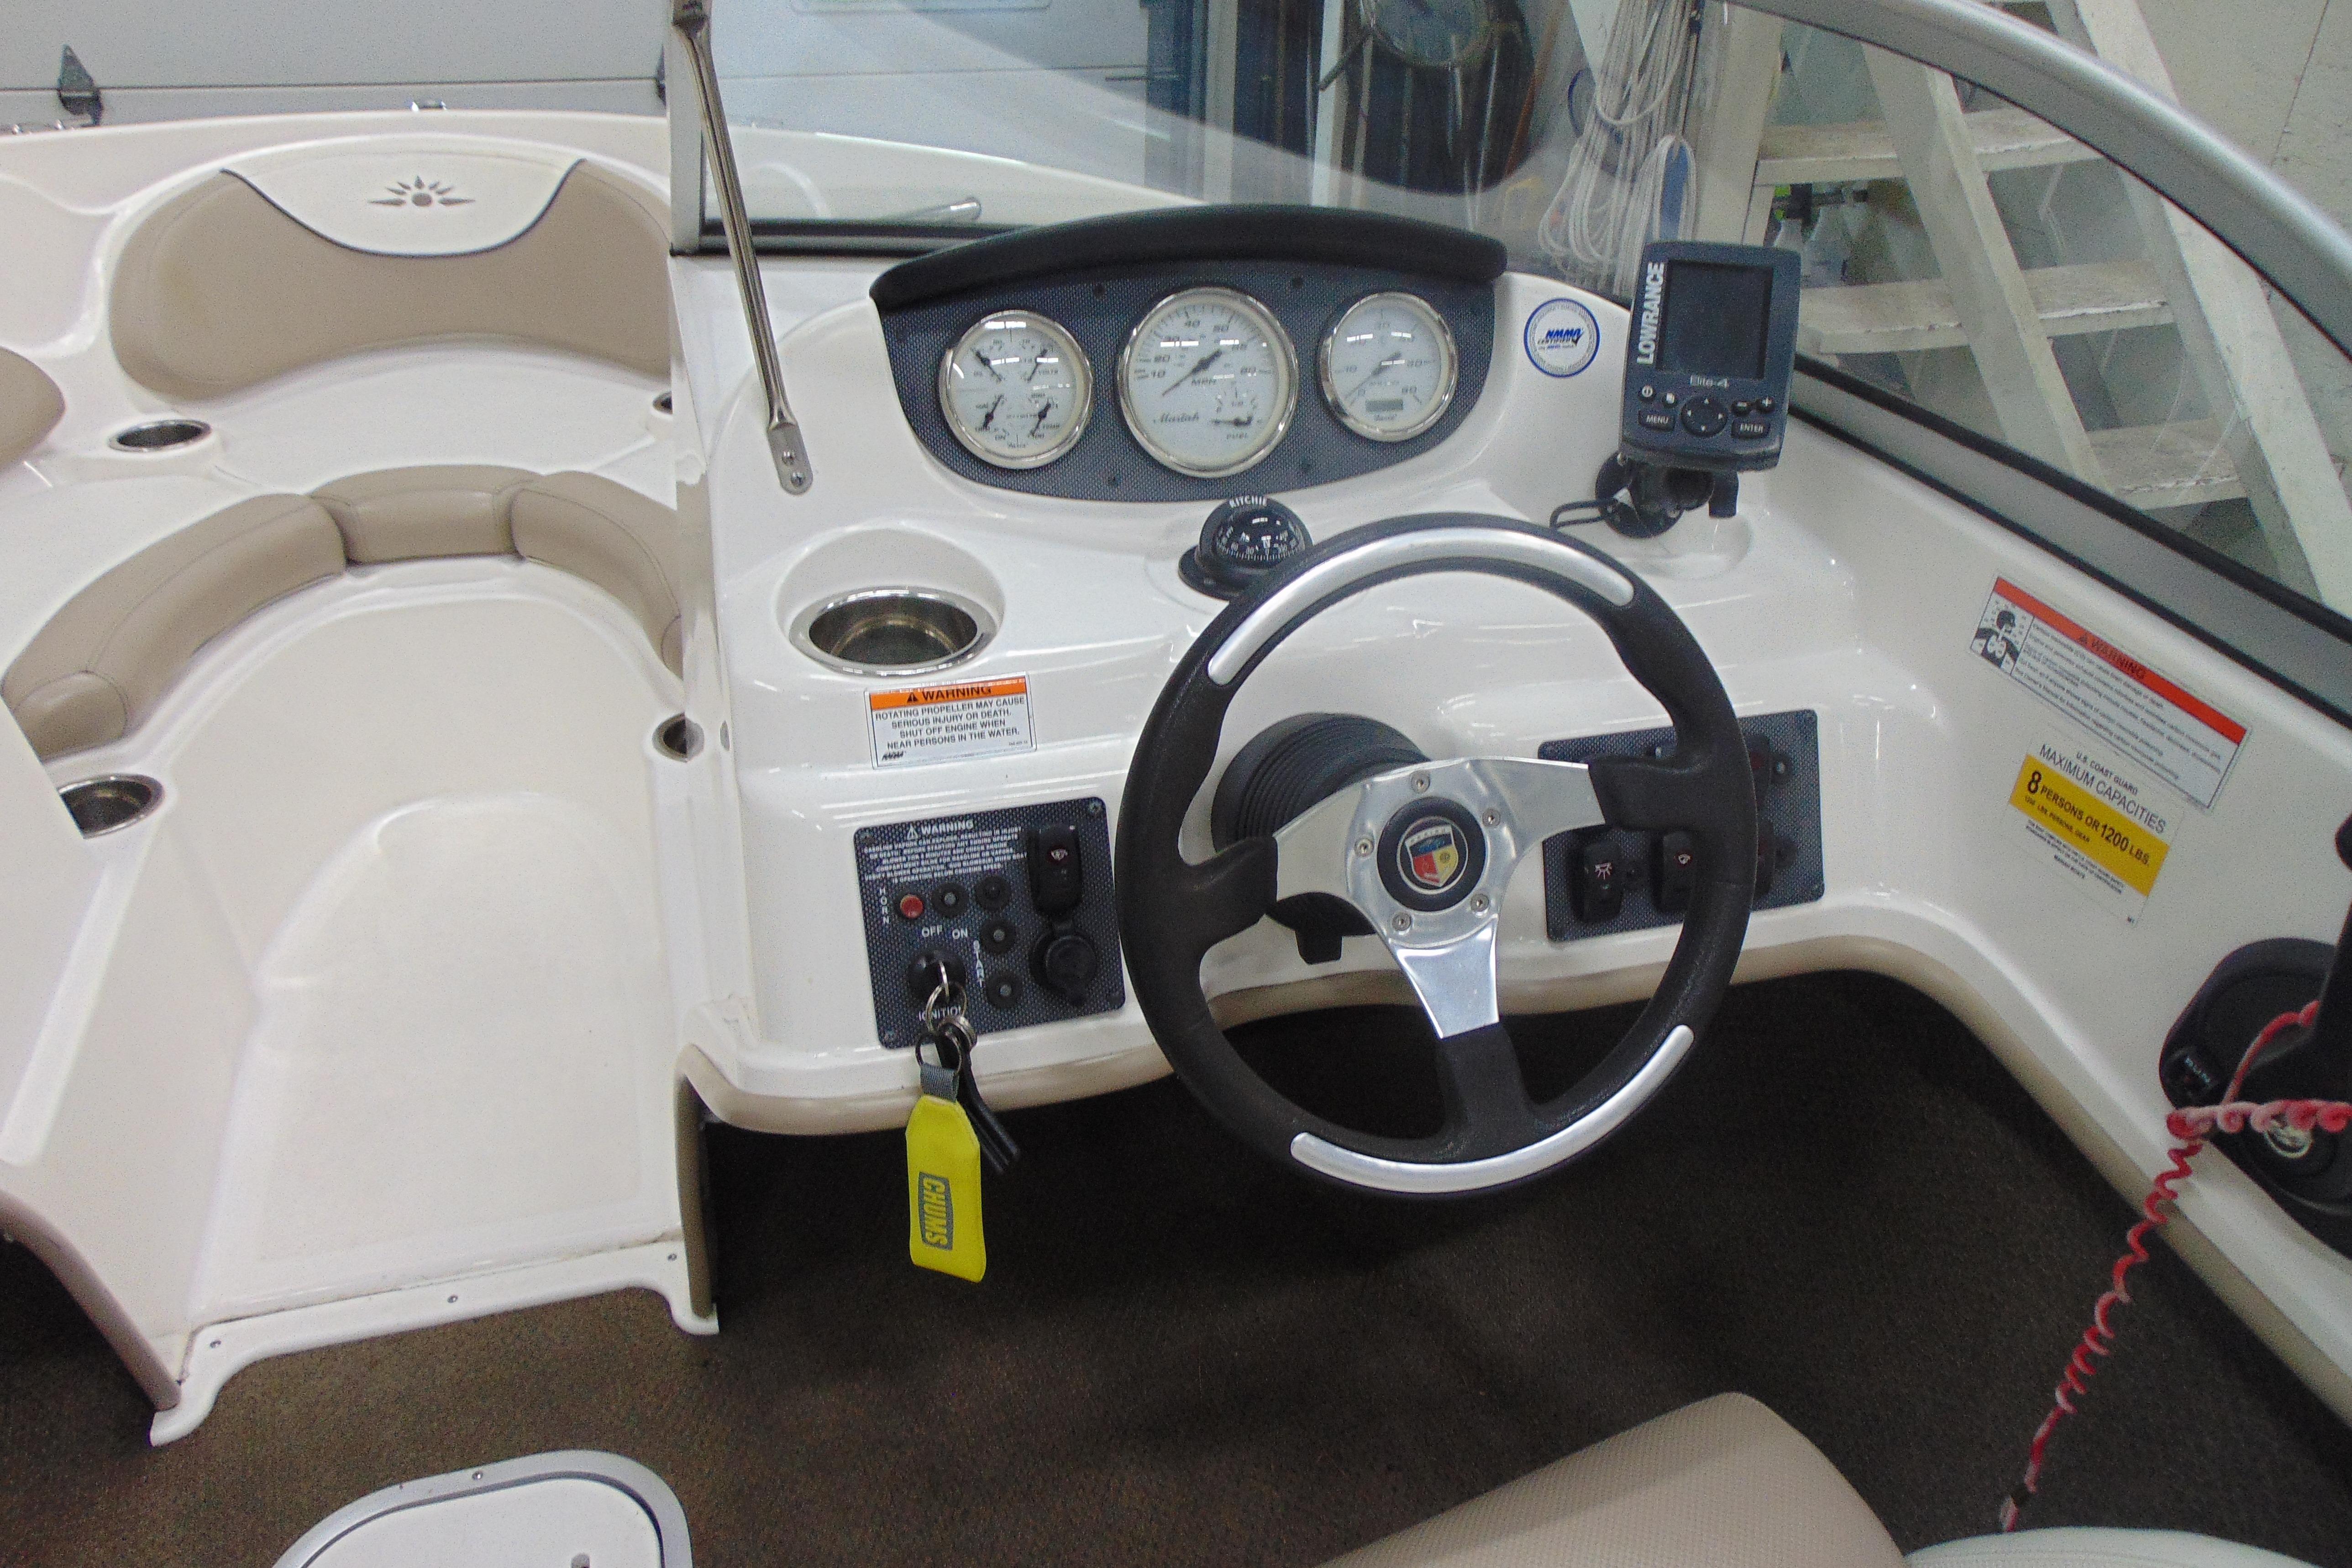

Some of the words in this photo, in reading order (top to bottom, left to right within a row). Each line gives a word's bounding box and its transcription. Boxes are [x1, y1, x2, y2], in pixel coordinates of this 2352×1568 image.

[1637, 262, 1664, 364] LOWRANCE
[1646, 414, 1669, 425] MENU
[1740, 423, 1764, 433] ENTER
[2091, 639, 2145, 680] WARNING
[922, 686, 992, 702] WARNING
[876, 709, 919, 721] ROTATING
[921, 702, 973, 715] PROPELLER
[976, 699, 993, 708] MAY
[996, 696, 1025, 707] CAUSE
[892, 717, 930, 729] SERIOUS
[933, 713, 963, 724] INJURY
[966, 712, 978, 720] OR
[887, 739, 911, 750] NEAR
[914, 734, 956, 748] PERSONS
[958, 733, 966, 743] IN
[970, 731, 986, 741] THE
[900, 728, 923, 739] SHUT
[925, 726, 943, 735] OFF
[945, 722, 977, 734] ENGINE
[980, 718, 1005, 729] WHEN
[2039, 744, 2095, 788] MAXIMUM
[2096, 780, 2167, 834] CAPACITIES
[2090, 760, 2114, 779] COAST
[2113, 776, 2138, 795] GUARD
[921, 820, 974, 835] WARNING
[2027, 770, 2042, 795] 8
[2040, 785, 2084, 821] PERSONS
[2085, 815, 2100, 833] OR
[2100, 823, 2130, 852] 1200
[2129, 844, 2151, 866] LBS.
[879, 887, 889, 924] HORN
[921, 924, 943, 938] OFF
[952, 927, 968, 939] ON
[973, 940, 984, 988] START
[923, 1176, 949, 1246] CHUMS
